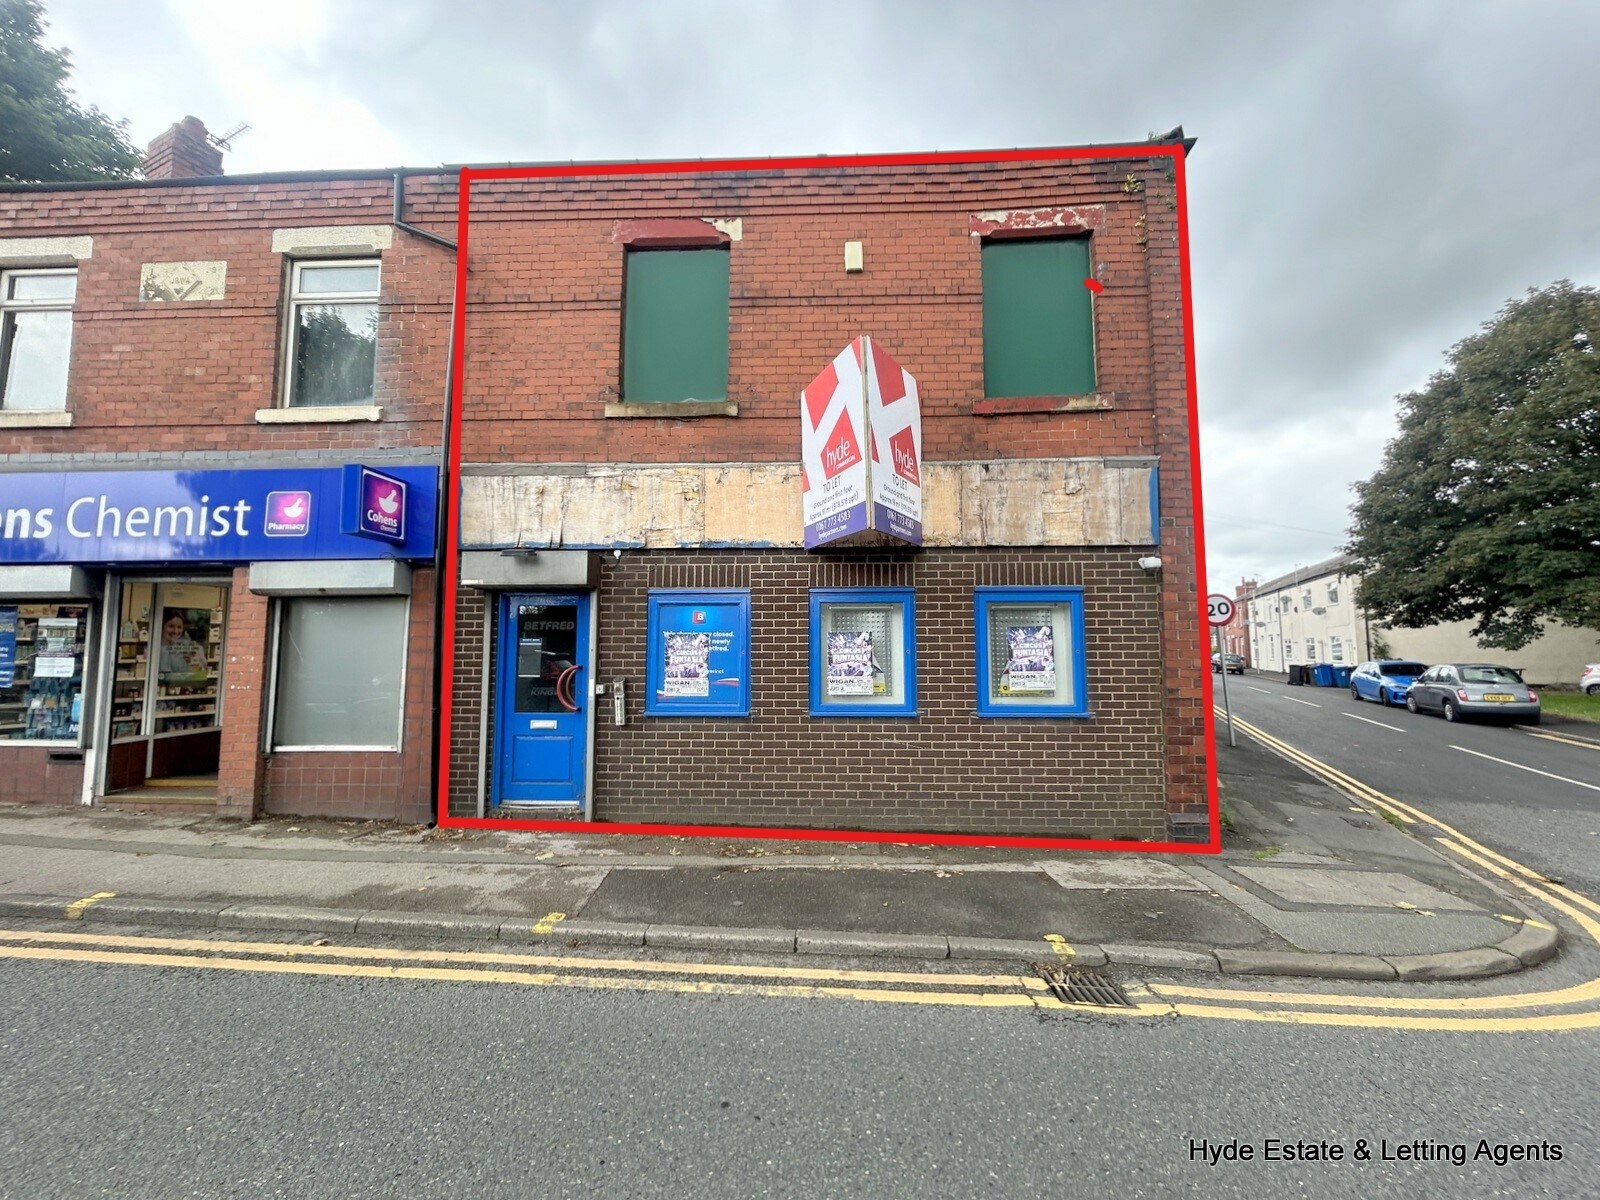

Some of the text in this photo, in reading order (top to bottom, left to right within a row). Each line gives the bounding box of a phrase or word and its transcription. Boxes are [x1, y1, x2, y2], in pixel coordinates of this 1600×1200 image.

[826, 436, 850, 472] hyde
[894, 439, 914, 473] hyde
[822, 475, 842, 494] TO LET
[892, 474, 908, 491] TO LET
[813, 497, 827, 509] Ground
[0, 495, 252, 539] ns Chemist
[367, 509, 398, 527] Cohens
[815, 509, 851, 533] 0161 773 4583
[268, 522, 305, 531] Pharmacy
[1208, 602, 1230, 617] 20
[524, 621, 575, 631] BETFRED
[670, 655, 704, 664] FUNTASIA
[833, 654, 869, 662] FUNTASIA
[1013, 649, 1049, 658] FUNTASIA
